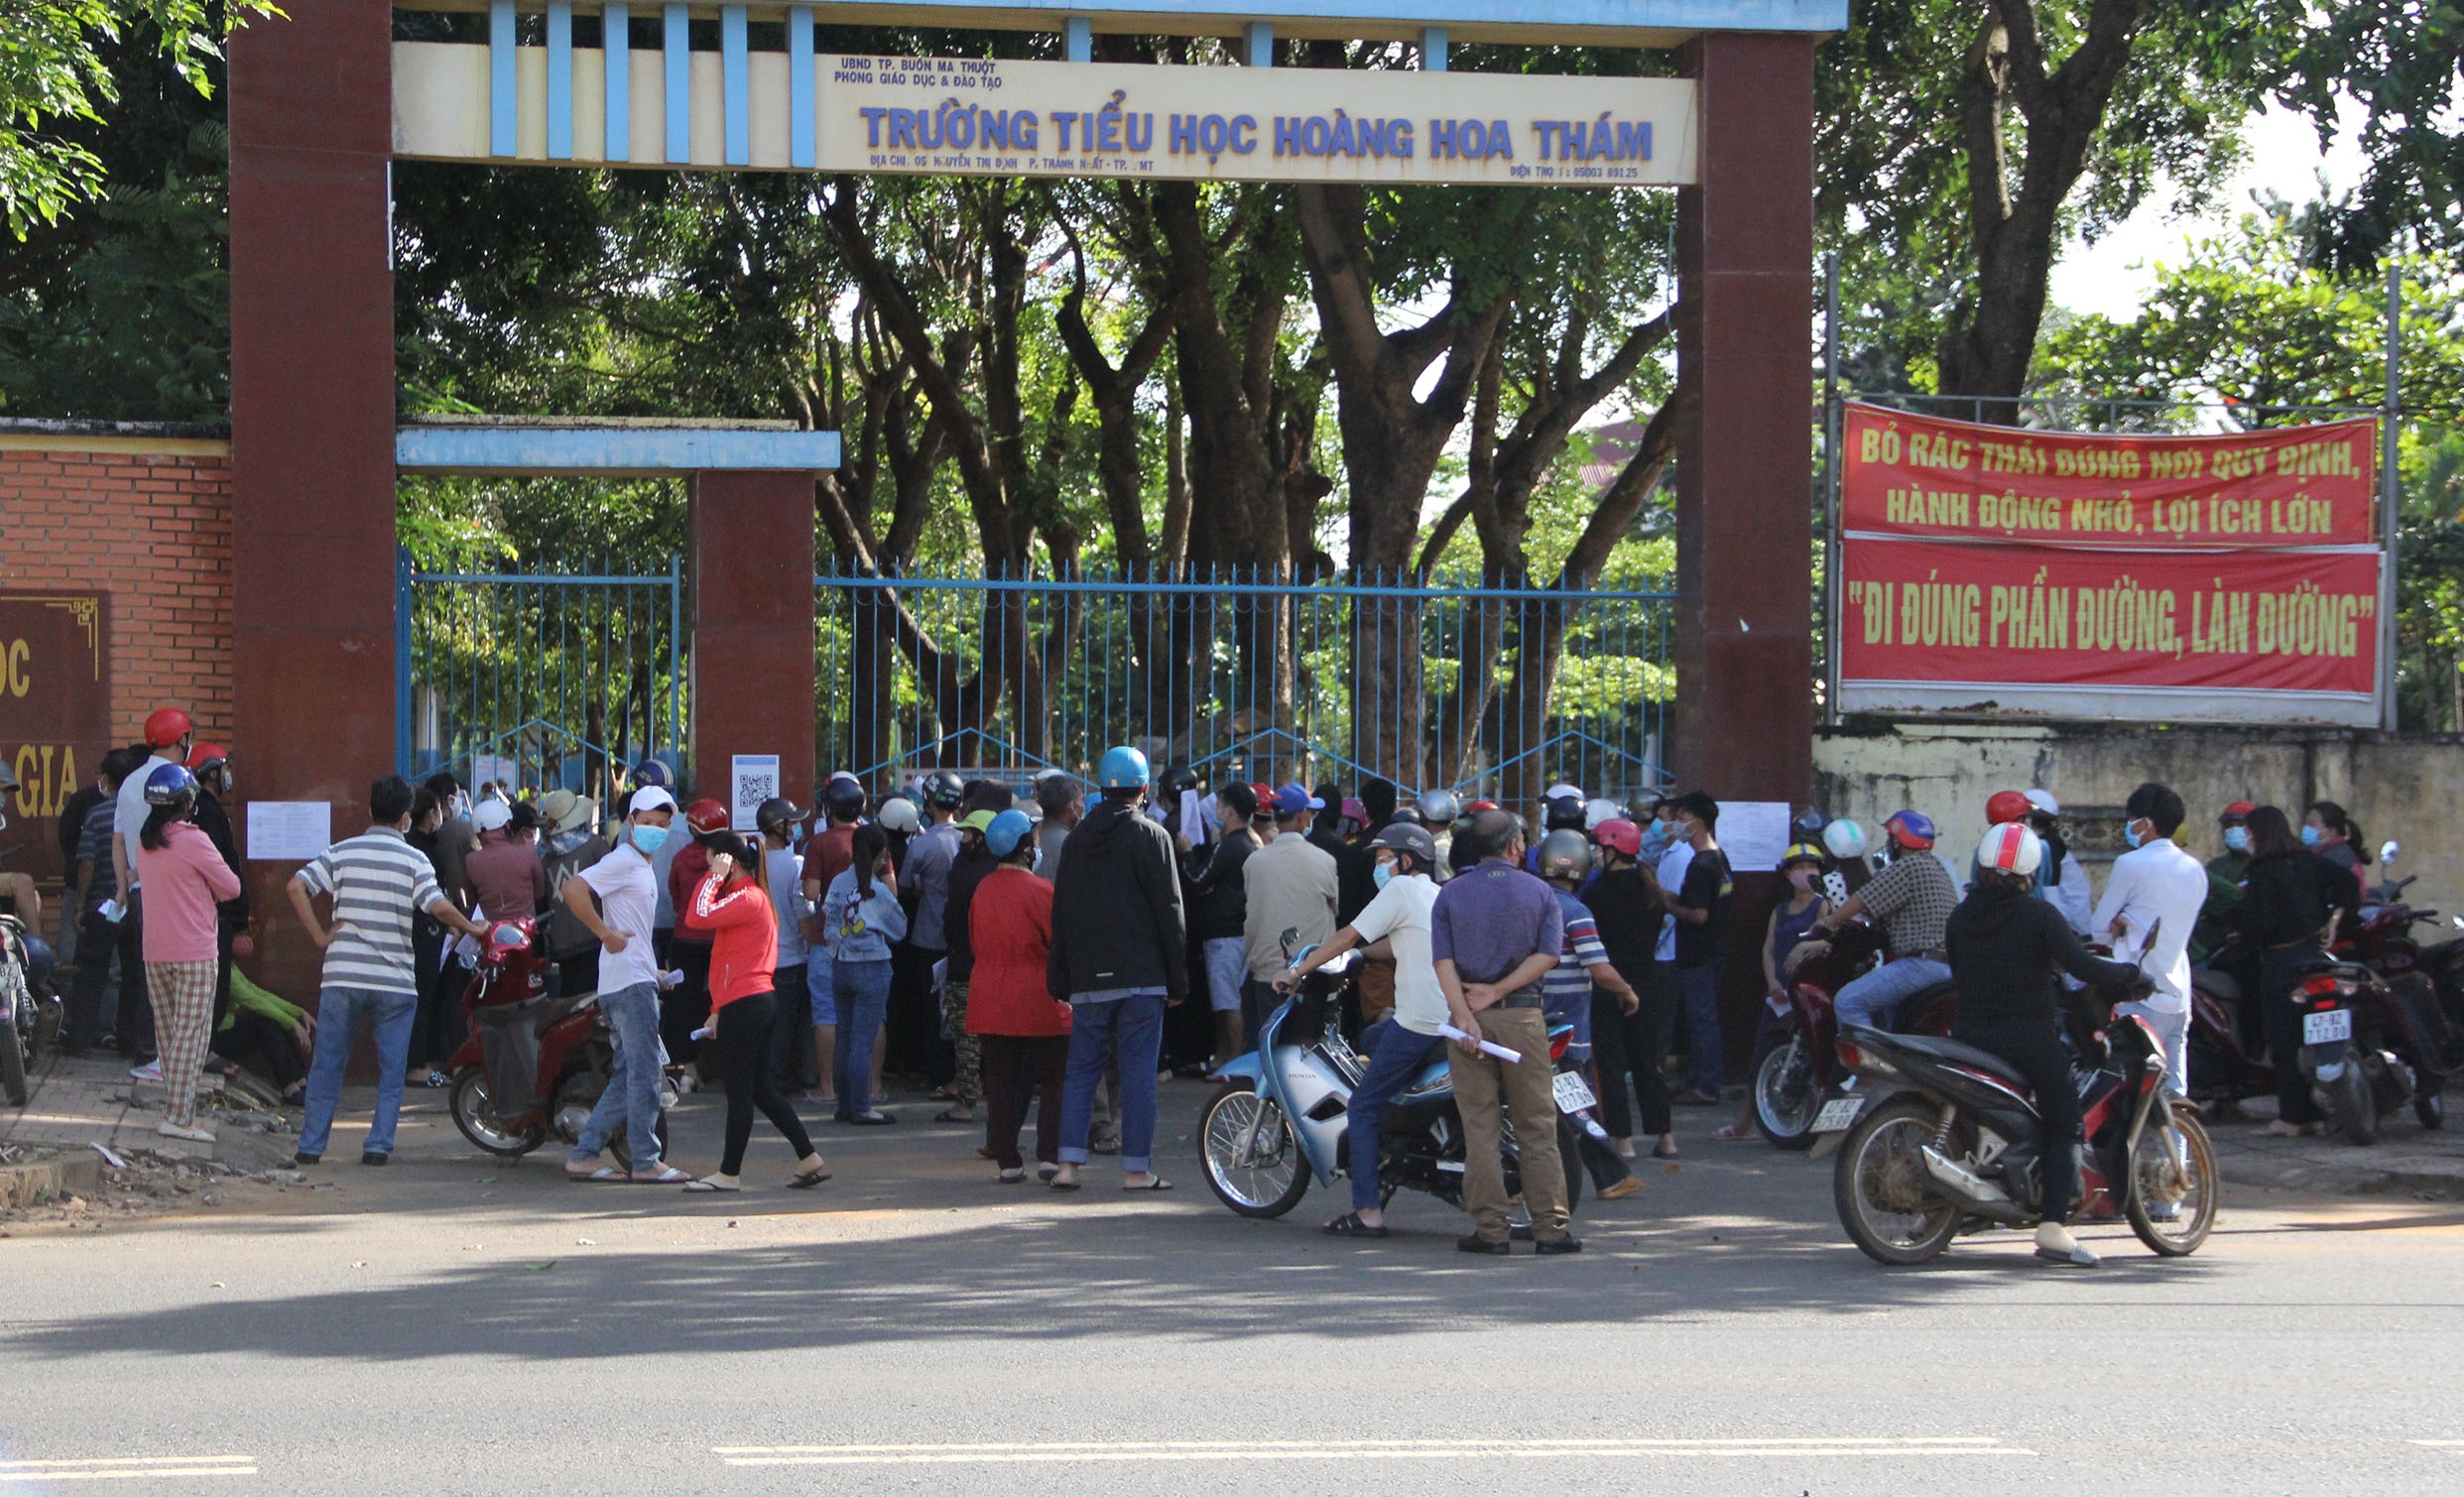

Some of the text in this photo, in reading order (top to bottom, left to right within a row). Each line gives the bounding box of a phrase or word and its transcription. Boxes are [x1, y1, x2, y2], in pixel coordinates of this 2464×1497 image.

[841, 58, 871, 69] UBND
[878, 61, 895, 71] TP.
[901, 58, 931, 71] BUÔN
[937, 62, 953, 72] MA
[880, 70, 906, 85] GIÁO
[914, 74, 935, 88] DỤC
[941, 75, 949, 87] &
[953, 73, 976, 87] ĐÀO
[981, 76, 1002, 91] TẠO
[859, 89, 1654, 164] TRƯỜNG TIỂU HỌC HOÀNG HOA THÁM
[915, 156, 927, 167] 05
[1029, 158, 1039, 169] P.
[1114, 159, 1128, 170] TP.
[1861, 421, 2361, 483] BỎ RÁC THẢI ĐÚNG NƠI QUY ĐỊNH,
[1887, 483, 2332, 540] HÀNH ĐỘNG NHỎ, LỢI ÍCH LỚN
[1901, 568, 1982, 647] ĐÚNG
[1989, 565, 2068, 650] PHẦN
[2076, 574, 2183, 661] ĐƯỜNG,
[2191, 576, 2251, 654] LÀN
[15, 744, 78, 818] GIA
